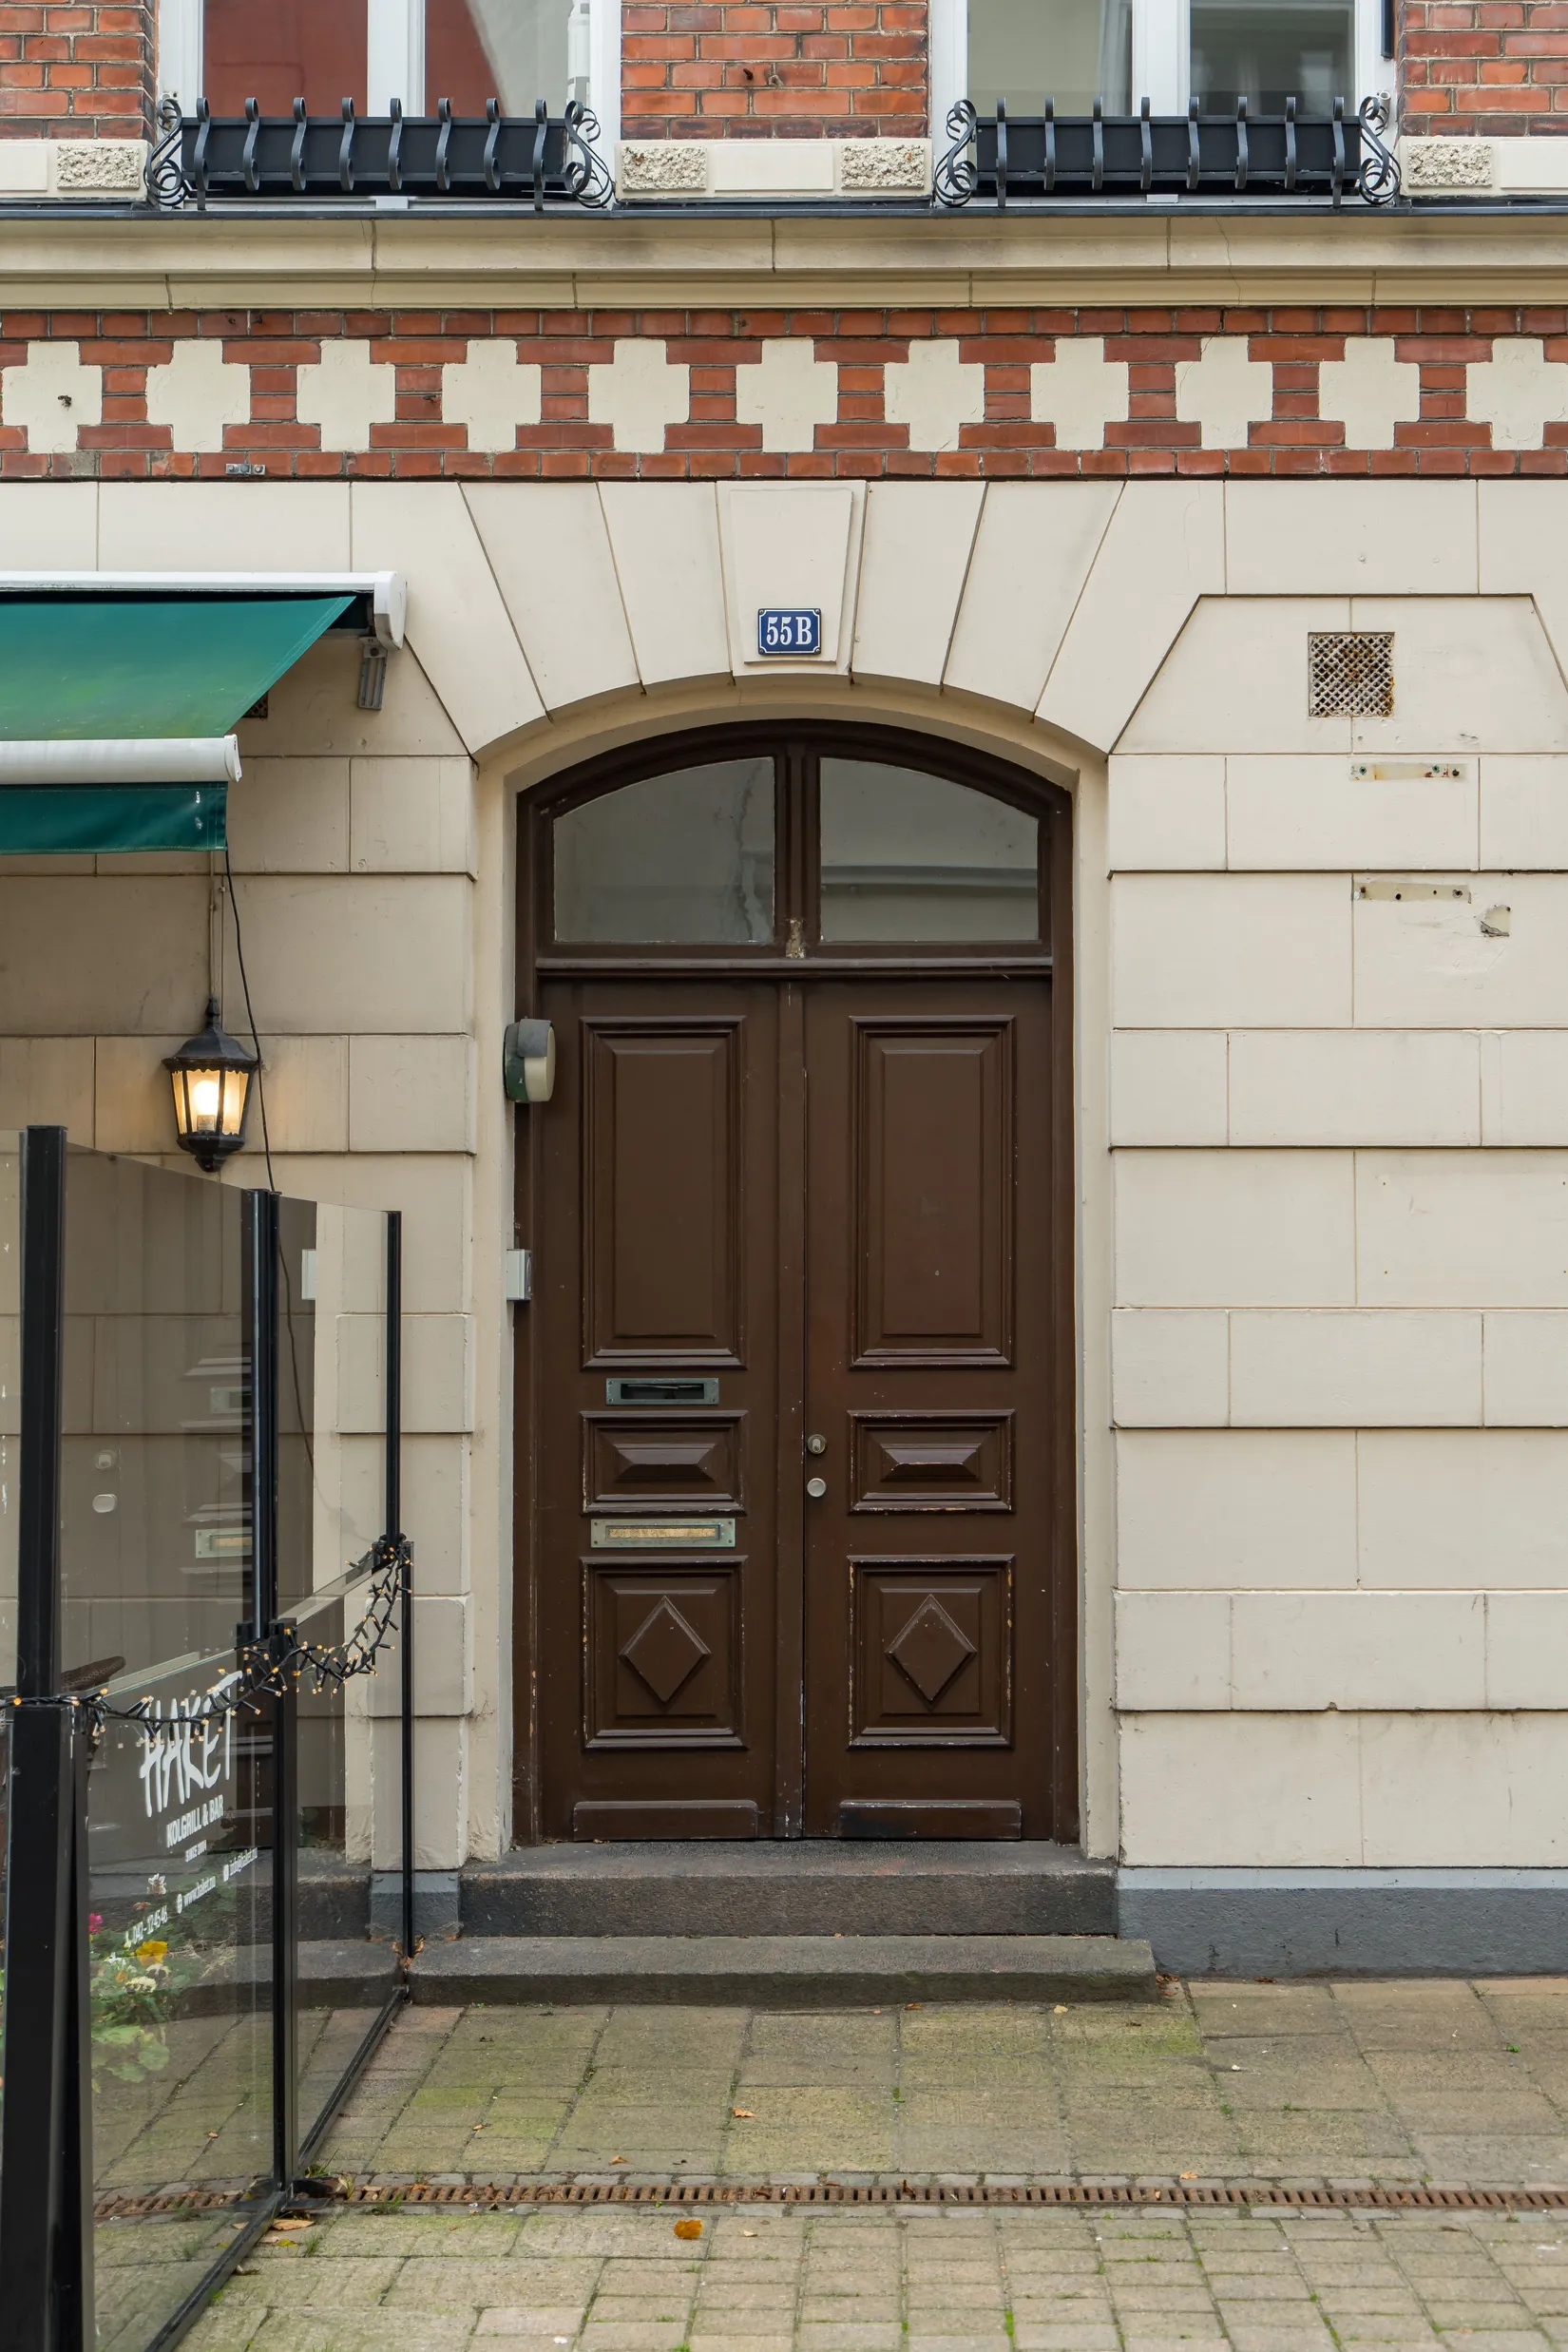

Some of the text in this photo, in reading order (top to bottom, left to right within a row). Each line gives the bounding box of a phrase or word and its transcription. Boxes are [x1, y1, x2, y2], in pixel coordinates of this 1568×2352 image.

[140, 1671, 242, 1817] HAKET
[166, 1794, 224, 1848] KOLGRILL & BAR
